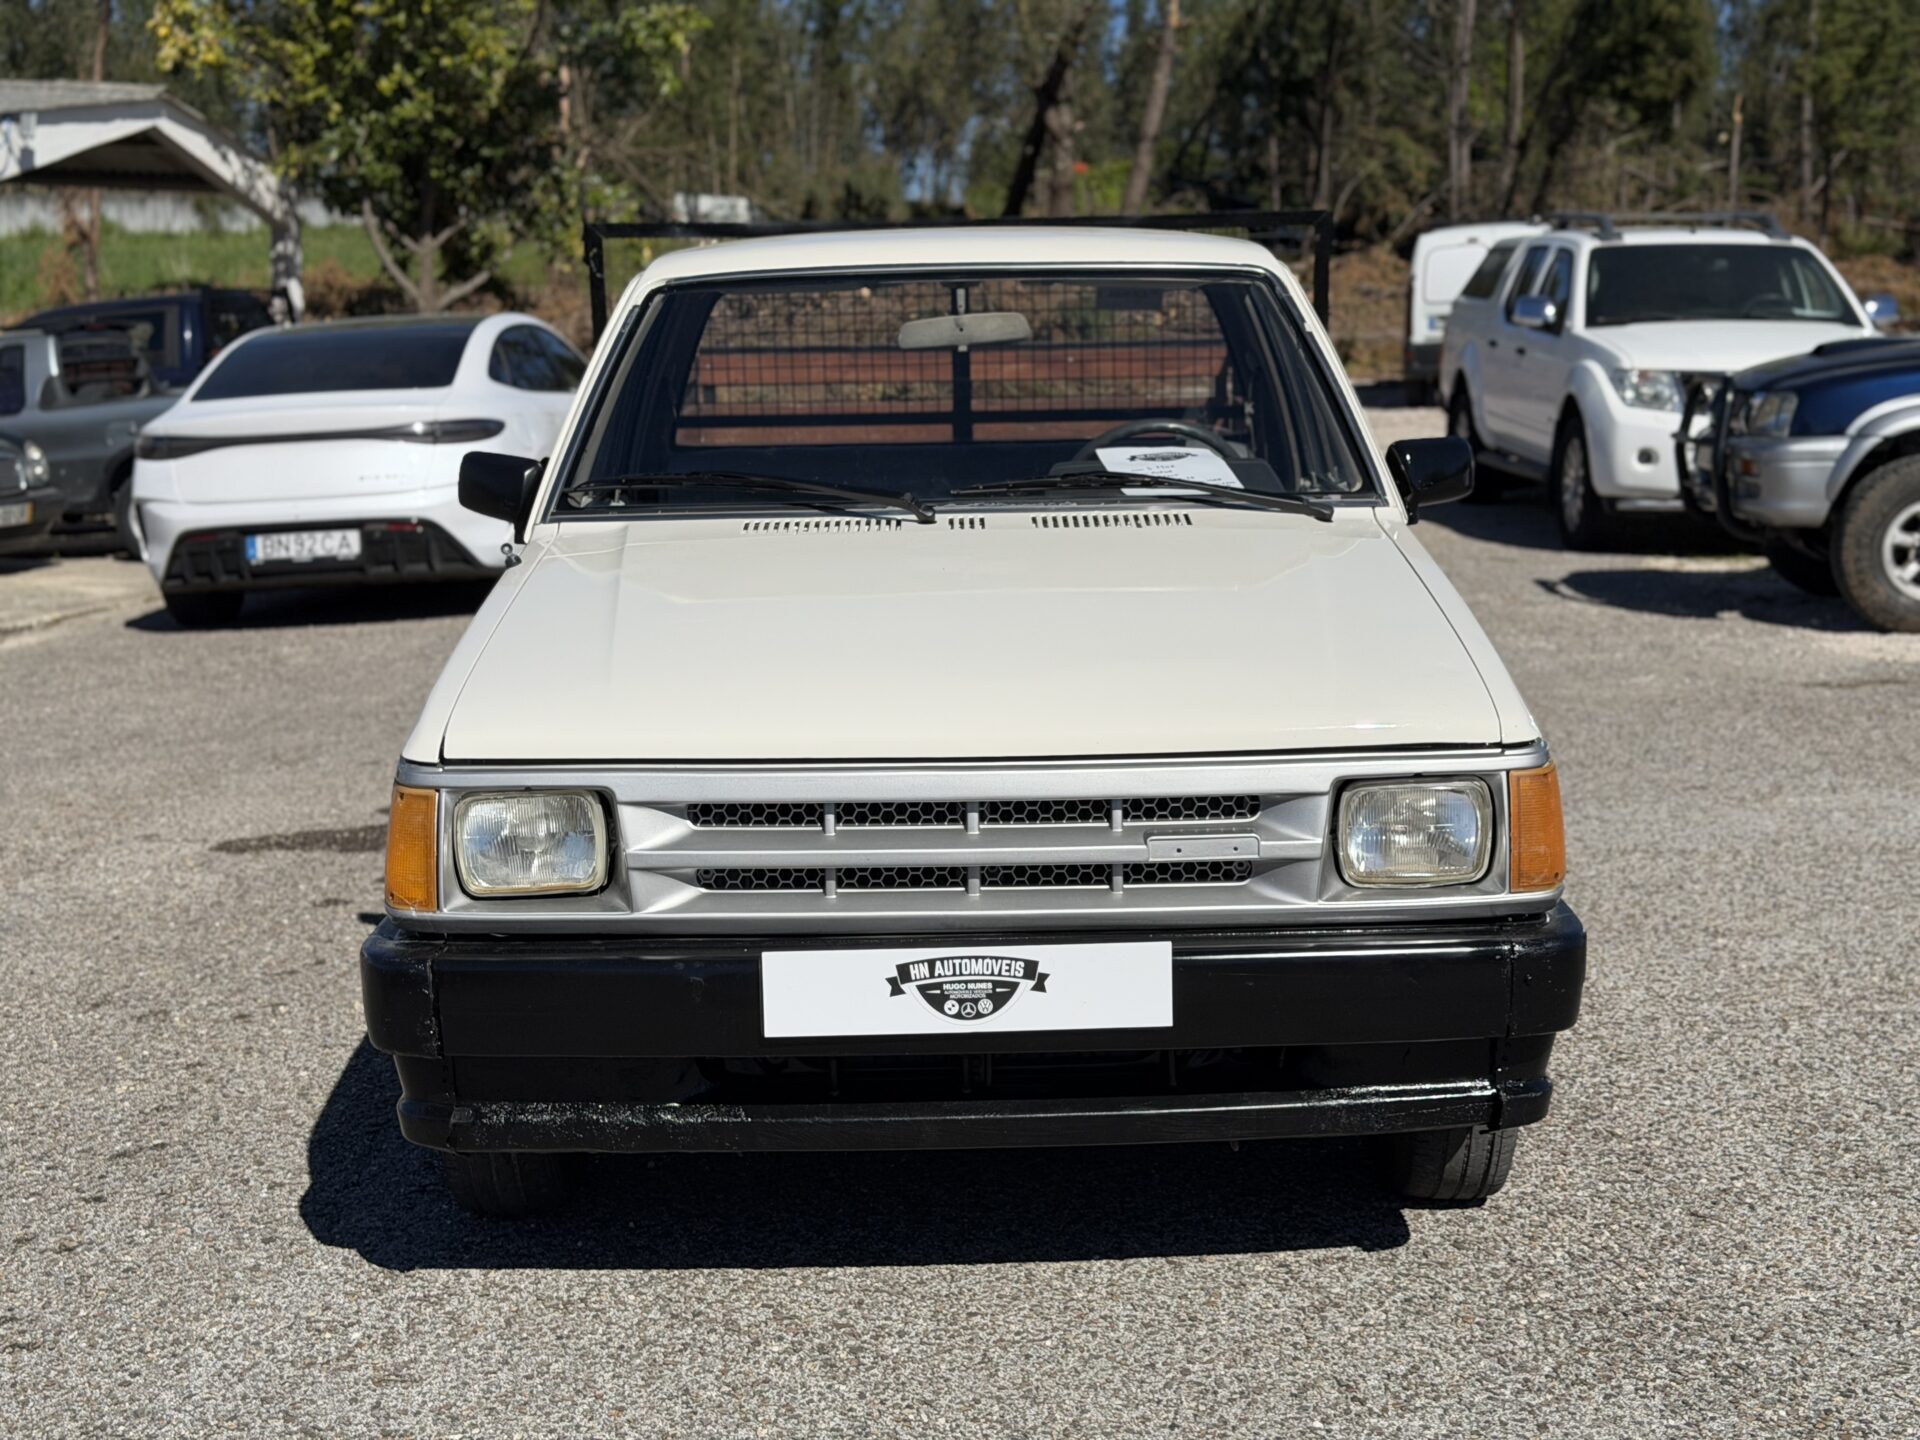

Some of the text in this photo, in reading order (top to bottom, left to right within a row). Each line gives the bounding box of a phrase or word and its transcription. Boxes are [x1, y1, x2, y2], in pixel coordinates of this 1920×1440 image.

[909, 957, 1026, 980] HN AUTOMÓVEIS
[967, 982, 993, 990] NUNES
